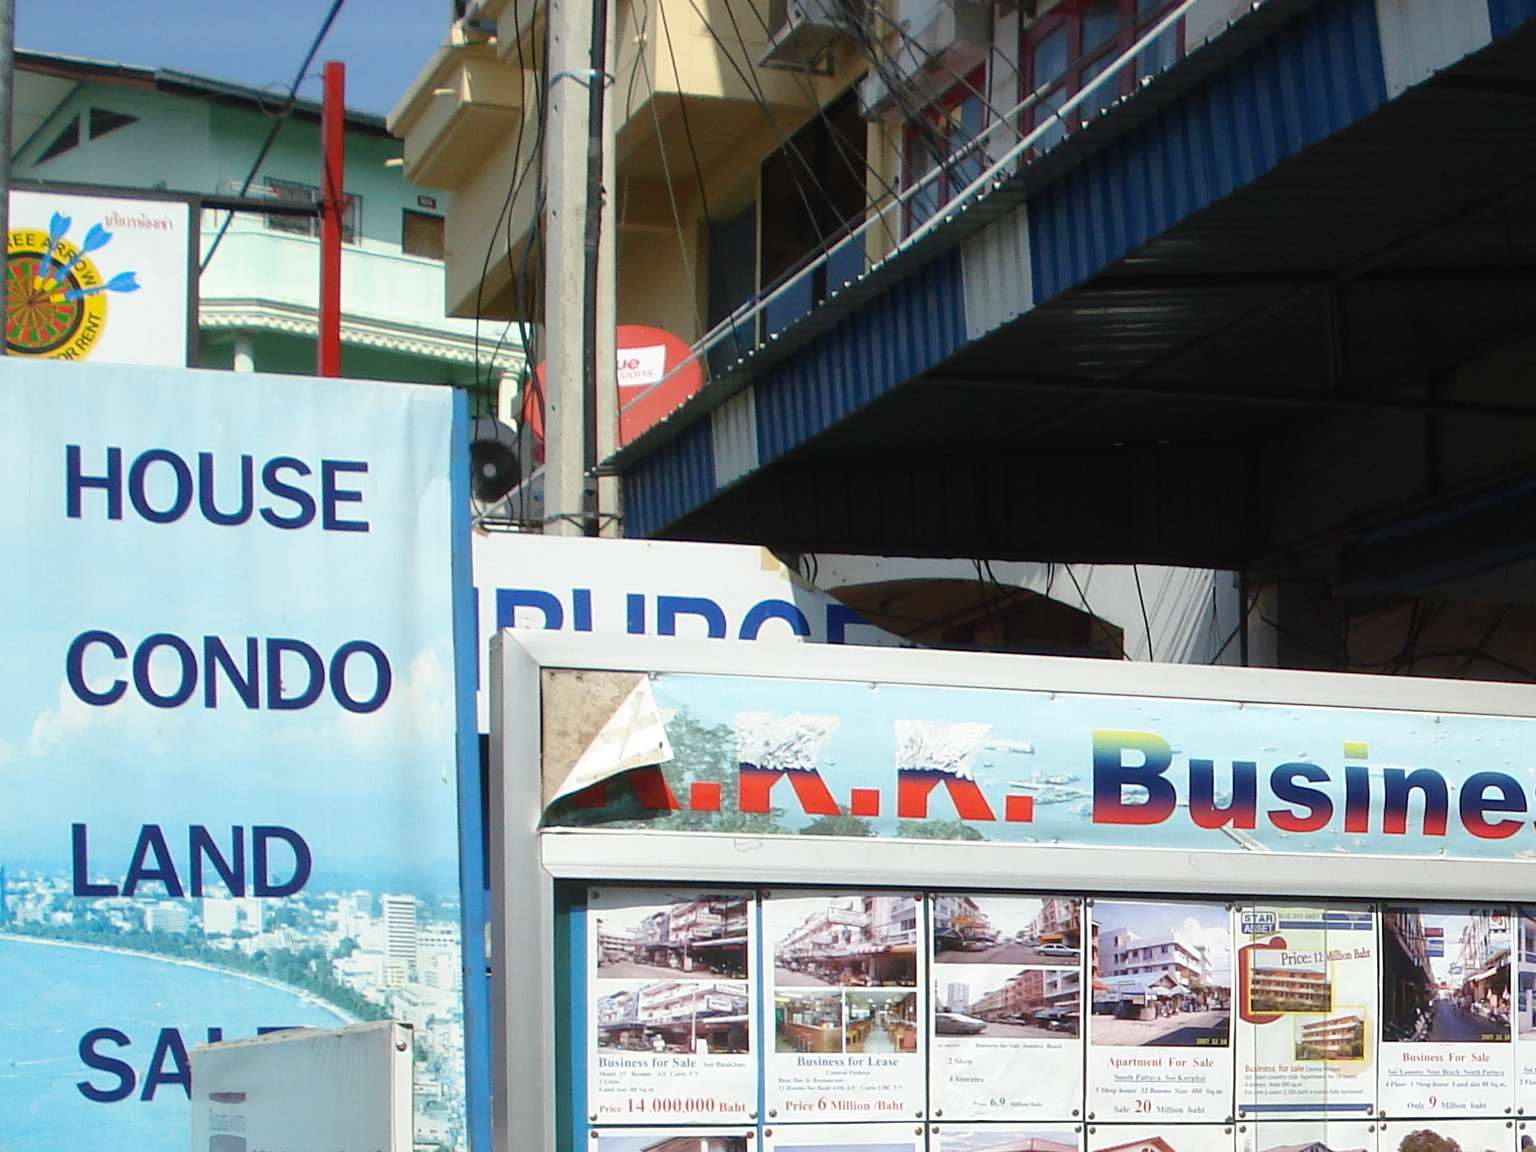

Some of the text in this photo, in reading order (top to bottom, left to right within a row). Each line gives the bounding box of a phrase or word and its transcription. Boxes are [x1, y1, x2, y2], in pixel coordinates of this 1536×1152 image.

[51, 311, 102, 361] OR RENT
[617, 358, 640, 370] ue
[620, 369, 653, 379] sions
[65, 444, 370, 533] HOUSE
[65, 630, 392, 714] CONDO
[72, 823, 312, 898] LAND
[1244, 914, 1273, 922] STAR
[1244, 924, 1274, 933] ASSET
[1281, 952, 1311, 965] Price:
[1314, 952, 1323, 963] 12
[598, 1057, 696, 1068] Business for Sale
[798, 1057, 898, 1067] Business for Lease
[1108, 1057, 1214, 1068] Apartment For Sale
[1403, 1053, 1490, 1062] Business For Sale
[719, 1102, 745, 1112] Baht
[786, 1097, 826, 1111] Price 6
[1134, 1100, 1151, 1114] 20
[1429, 1096, 1437, 1108] 9
